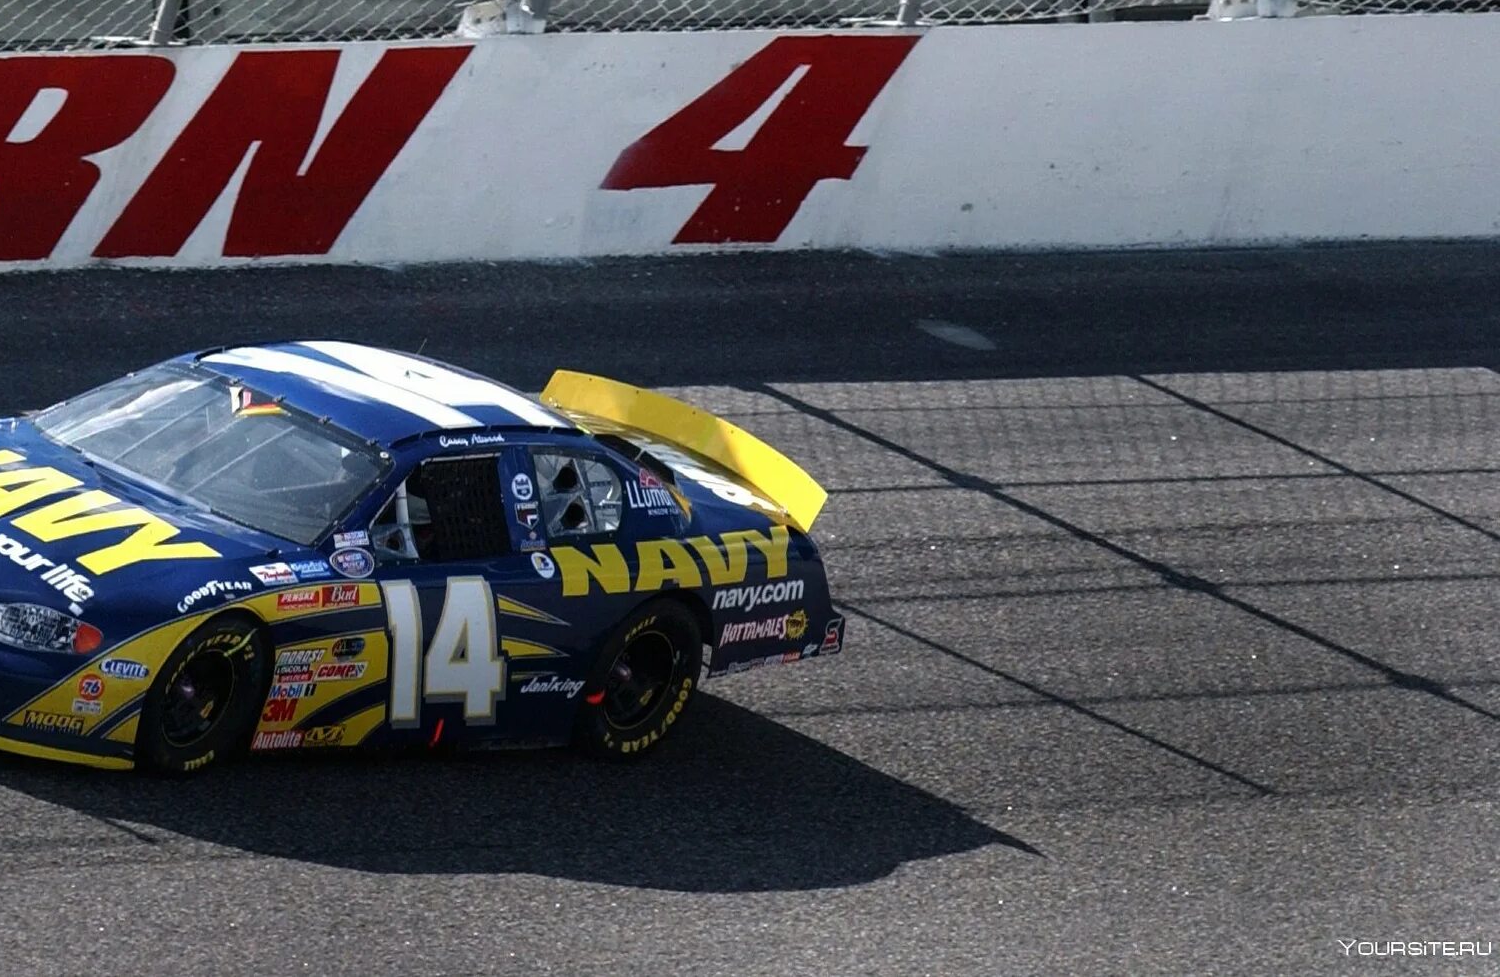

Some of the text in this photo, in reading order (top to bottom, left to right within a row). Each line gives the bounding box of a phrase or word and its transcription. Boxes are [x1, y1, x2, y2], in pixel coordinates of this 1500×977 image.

[598, 35, 924, 244] 4
[551, 525, 789, 597] NAVY
[176, 579, 252, 614] GOODYEAR
[331, 585, 358, 603] Bud
[712, 579, 805, 612] navy.com
[379, 575, 508, 729] 14
[317, 664, 356, 678] COMP
[81, 679, 101, 697] 76
[269, 684, 302, 699] Mobil
[26, 710, 84, 730] MOOG
[262, 699, 298, 722] 3M
[253, 730, 303, 750] Autolite
